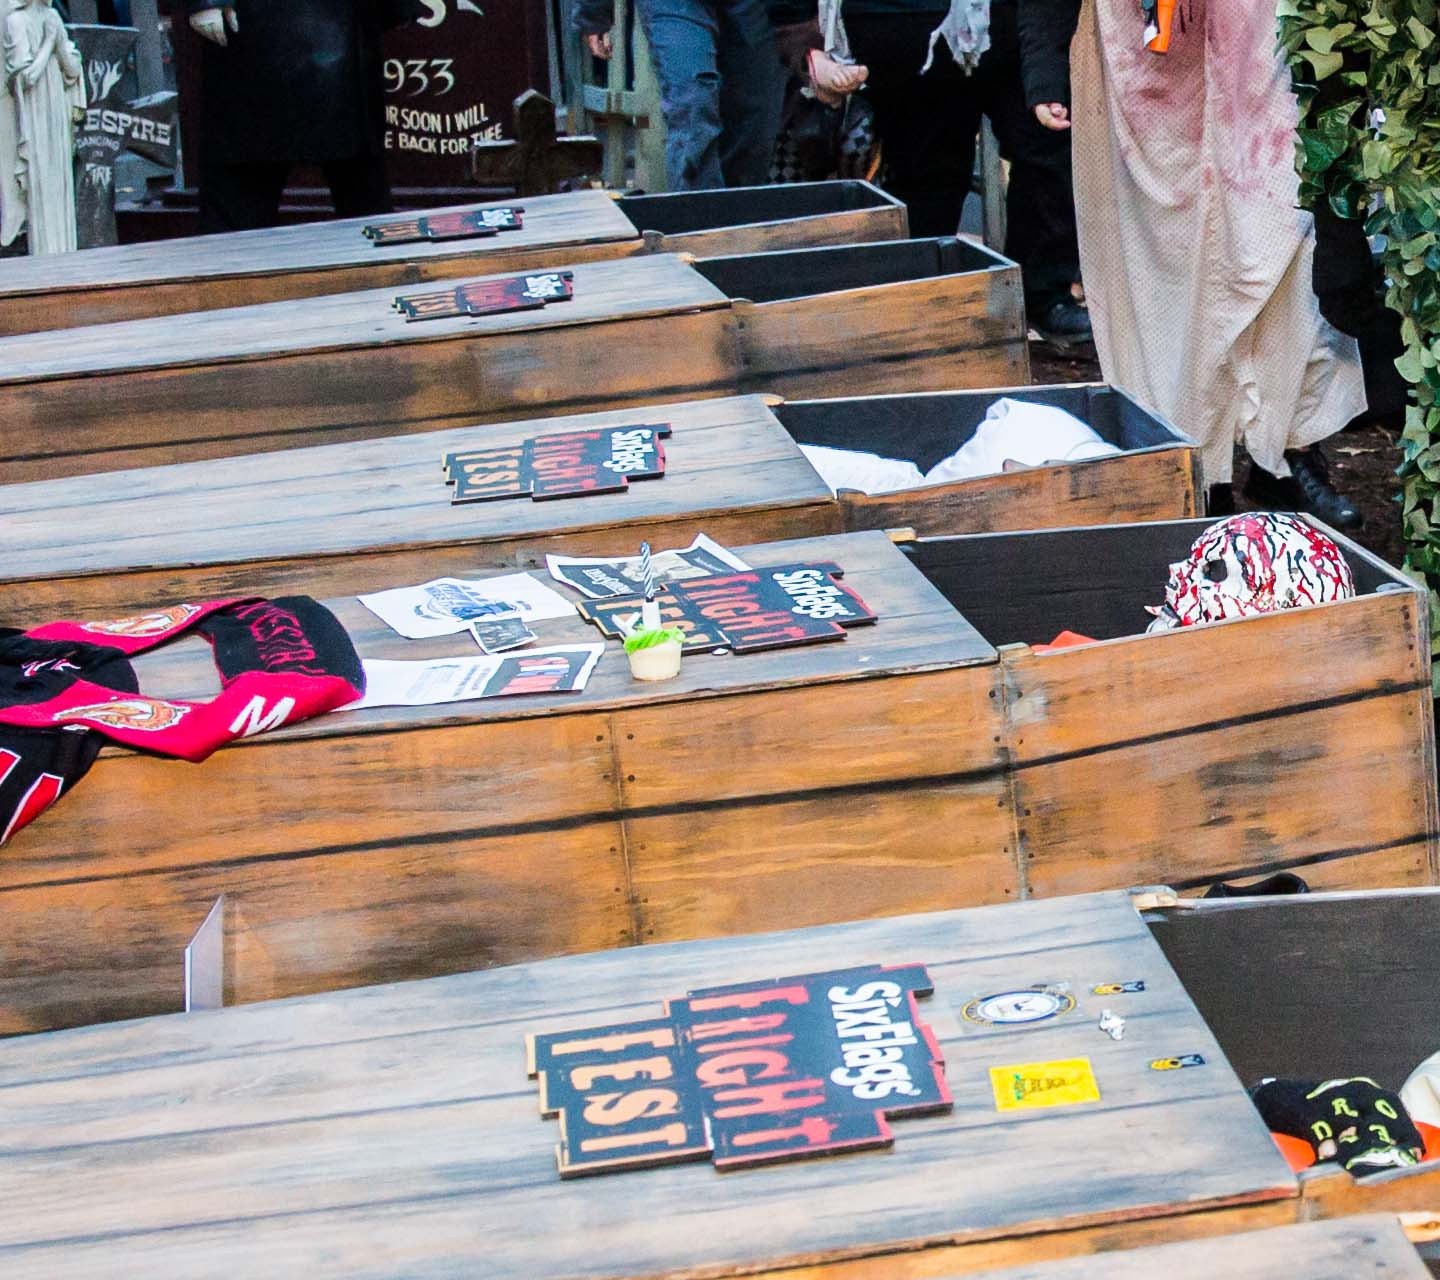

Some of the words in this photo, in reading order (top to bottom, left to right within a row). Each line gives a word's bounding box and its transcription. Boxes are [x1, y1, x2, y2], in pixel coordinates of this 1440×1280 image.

[74, 108, 171, 146] ESPIRE
[401, 107, 442, 134] SOON
[445, 114, 451, 133] I
[455, 103, 489, 132] WILL
[398, 132, 437, 154] BACK
[440, 138, 468, 155] FOR
[688, 984, 838, 1148] FRIGHT
[551, 1028, 689, 1153] FEST
